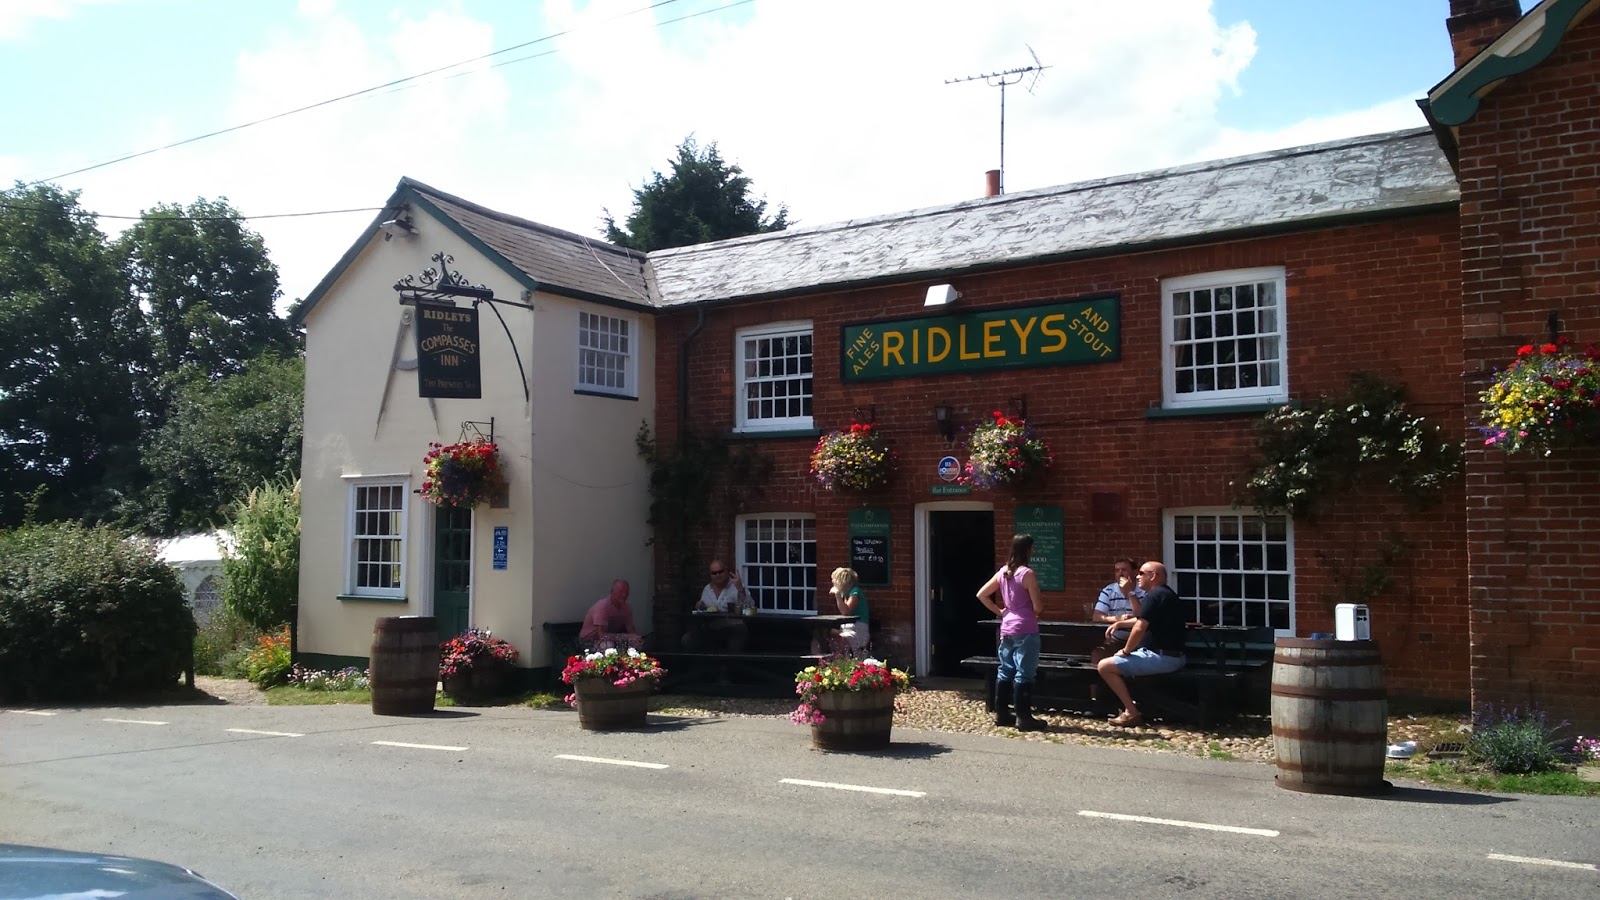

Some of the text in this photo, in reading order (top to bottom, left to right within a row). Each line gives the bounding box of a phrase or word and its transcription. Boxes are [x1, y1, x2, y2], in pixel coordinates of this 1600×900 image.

[423, 310, 471, 322] RIDLEYS
[442, 323, 453, 332] The
[1081, 307, 1110, 334] AND
[421, 335, 476, 354] COMPASSES
[847, 328, 873, 359] FINE
[882, 314, 1068, 367] RIDLEYS
[1068, 319, 1112, 358] STOUT
[441, 354, 459, 366] INN
[852, 341, 880, 375] ALES
